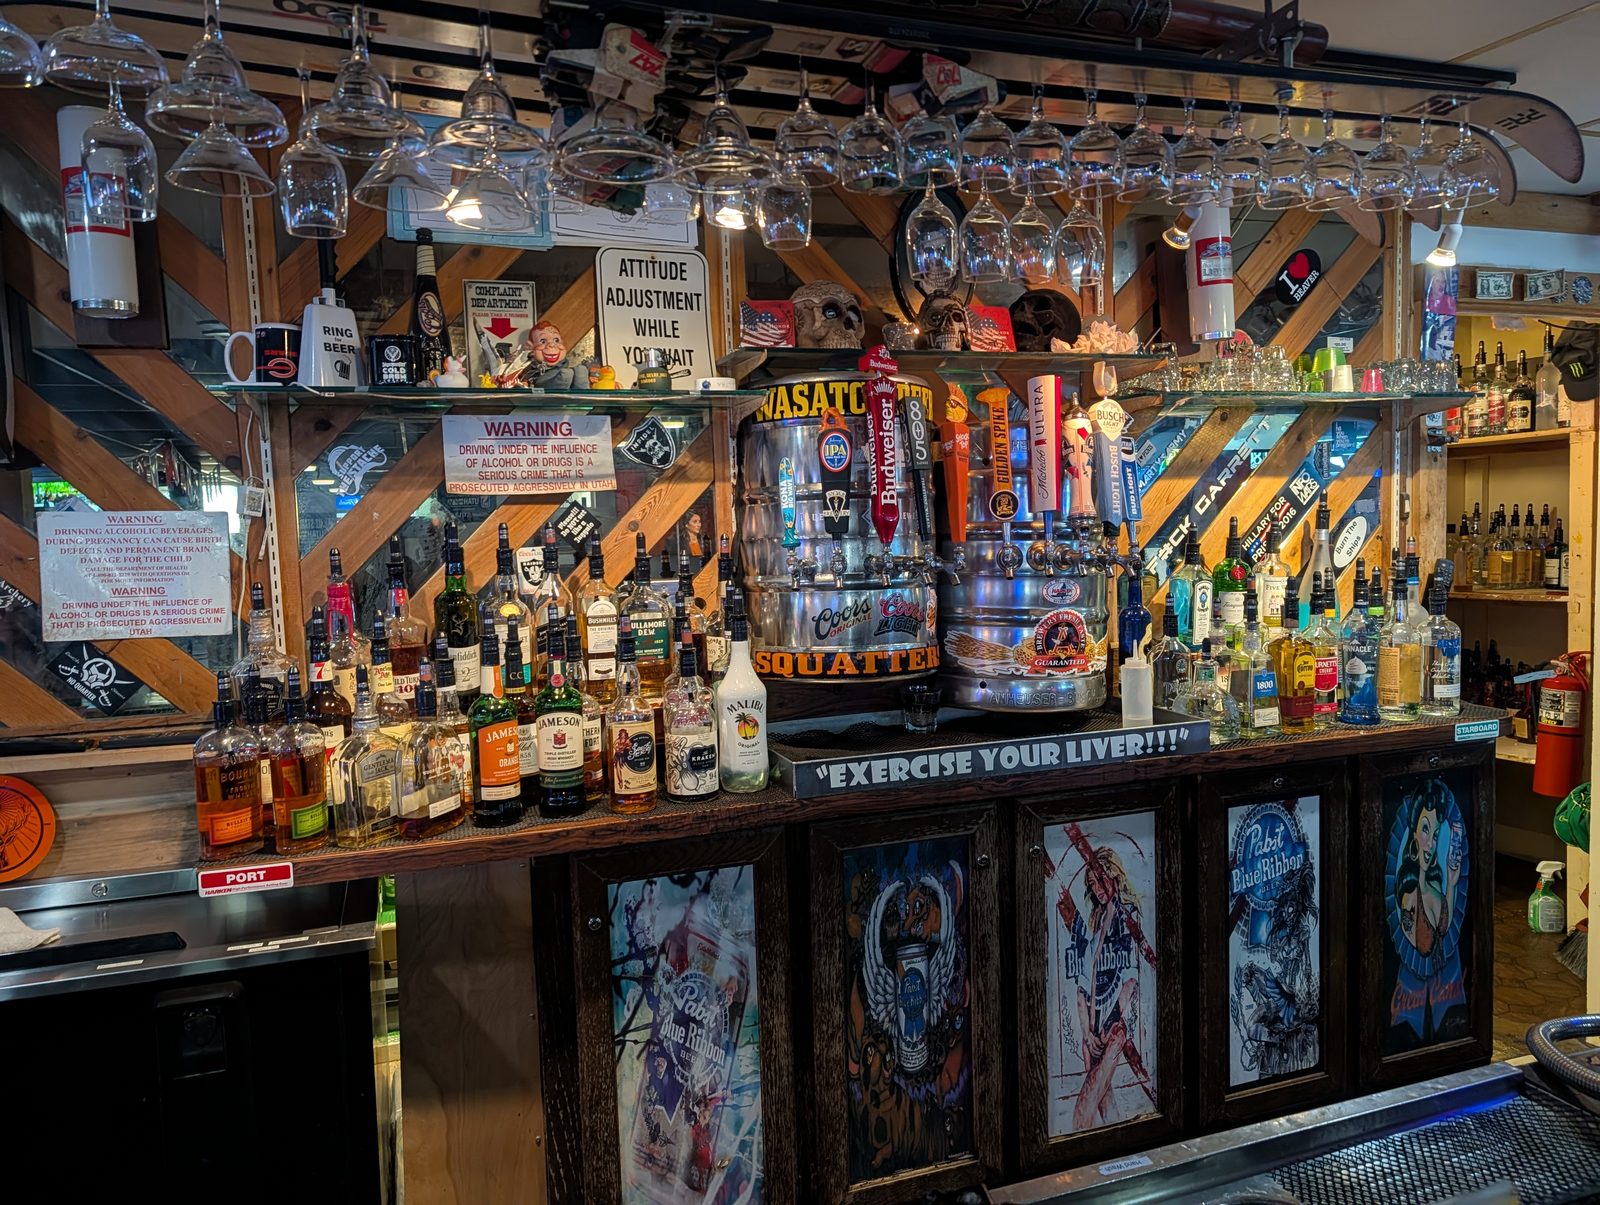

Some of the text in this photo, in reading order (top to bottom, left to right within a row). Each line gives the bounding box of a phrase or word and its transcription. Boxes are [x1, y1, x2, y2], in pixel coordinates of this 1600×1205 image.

[619, 257, 688, 281] ATTITUDE
[475, 286, 523, 297] COMPLAINT
[1279, 270, 1299, 295] I
[1293, 270, 1320, 302] BEAVER
[471, 298, 529, 309] DEPARTMENT
[606, 287, 702, 312] ADJUSTMENT
[322, 325, 354, 338] RING
[633, 318, 680, 339] WHILE
[324, 342, 356, 355] BEER
[663, 348, 694, 367] WAIT
[869, 359, 898, 371] Budweiser
[754, 381, 866, 422] WASATC
[1096, 409, 1125, 424] BUSCH
[484, 421, 573, 437] WARNING
[630, 425, 656, 452] INFIDEL
[908, 400, 930, 461] 805
[459, 444, 598, 455] DRIVING UNDER THE INFLUENCE
[825, 444, 847, 457] IPA
[991, 406, 1010, 484] GOLDEN SPIKE
[1034, 384, 1049, 500] Michelob ULTRA
[347, 444, 385, 479] STACHE
[865, 411, 878, 496] Budweiser
[878, 398, 897, 507] Budweiser
[335, 446, 366, 479] SUPPORT
[466, 457, 593, 468] OF ALCOHOL OR DRUGS IS A
[478, 469, 584, 481] SERIOUS CRIME THAT IS
[1108, 444, 1121, 516] BUSCH LIGHT
[449, 483, 509, 493] PROSECUTED
[513, 482, 576, 492] AGGRESSIVELY
[580, 481, 588, 489] IN
[780, 479, 789, 508] KONA
[1125, 467, 1138, 515] BUD LIGHT
[1145, 420, 1271, 576] F#CK GARRETT
[107, 515, 163, 524] WARNING
[566, 516, 580, 530] NOT
[1241, 495, 1287, 551] HILLARY FOR
[1278, 506, 1297, 530] 2016
[45, 537, 84, 545] DURING
[85, 537, 142, 545] PREGNANCY
[164, 536, 193, 544] CAUSE
[195, 536, 223, 544] BIRTH
[54, 526, 214, 536] DRINKING ALCOHOLIC BEVERAGES
[1335, 520, 1358, 555] Burn The
[60, 545, 211, 555] DEFECTS AND PERMANENT BRAIN
[1346, 535, 1362, 557] Ships
[80, 556, 122, 564] DAMAGE
[123, 556, 142, 564] FOR
[163, 555, 193, 563] CHILD
[0, 579, 34, 608] Archery
[111, 586, 166, 596] WARNING
[48, 611, 93, 620] ALCOHOL
[110, 610, 141, 618] DRUGS
[142, 609, 151, 617] IS
[152, 609, 159, 617] A
[160, 608, 197, 616] SERIOUS
[199, 607, 226, 615] CRIME
[62, 602, 99, 610] DRIVING
[100, 601, 131, 609] UNDER
[132, 601, 151, 609] THE
[152, 600, 200, 608] INFLUENCE
[878, 592, 925, 622] Coors
[51, 617, 222, 630] THAT IS PROSECUTED AGGRESSIVELY IN
[587, 616, 617, 625] BUSHMILLS
[811, 598, 872, 641] Coors
[829, 613, 872, 639] ORIGINAL
[874, 616, 921, 637] LIGHT
[129, 627, 153, 636] UTAH
[1036, 615, 1058, 651] BREWERY
[312, 662, 327, 680] 7
[1034, 657, 1086, 667] GUARANTEED
[66, 677, 77, 686] NO
[74, 681, 97, 701] QUARTER
[1256, 680, 1273, 690] 1800
[725, 700, 766, 716] MALIBU
[538, 716, 582, 731] JAMESON
[1456, 723, 1498, 736] STARBOARD
[736, 740, 761, 750] ORIGINAL
[691, 753, 716, 762] KRAKEN
[977, 744, 1063, 774] YOUR
[1246, 822, 1286, 860] Pabst
[226, 870, 266, 884] PORT
[1231, 851, 1304, 894] Blue Ribbon
[204, 887, 232, 896] HARKEN
[671, 981, 720, 1029] Pabst
[659, 1011, 726, 1067] Blue Ribbon
